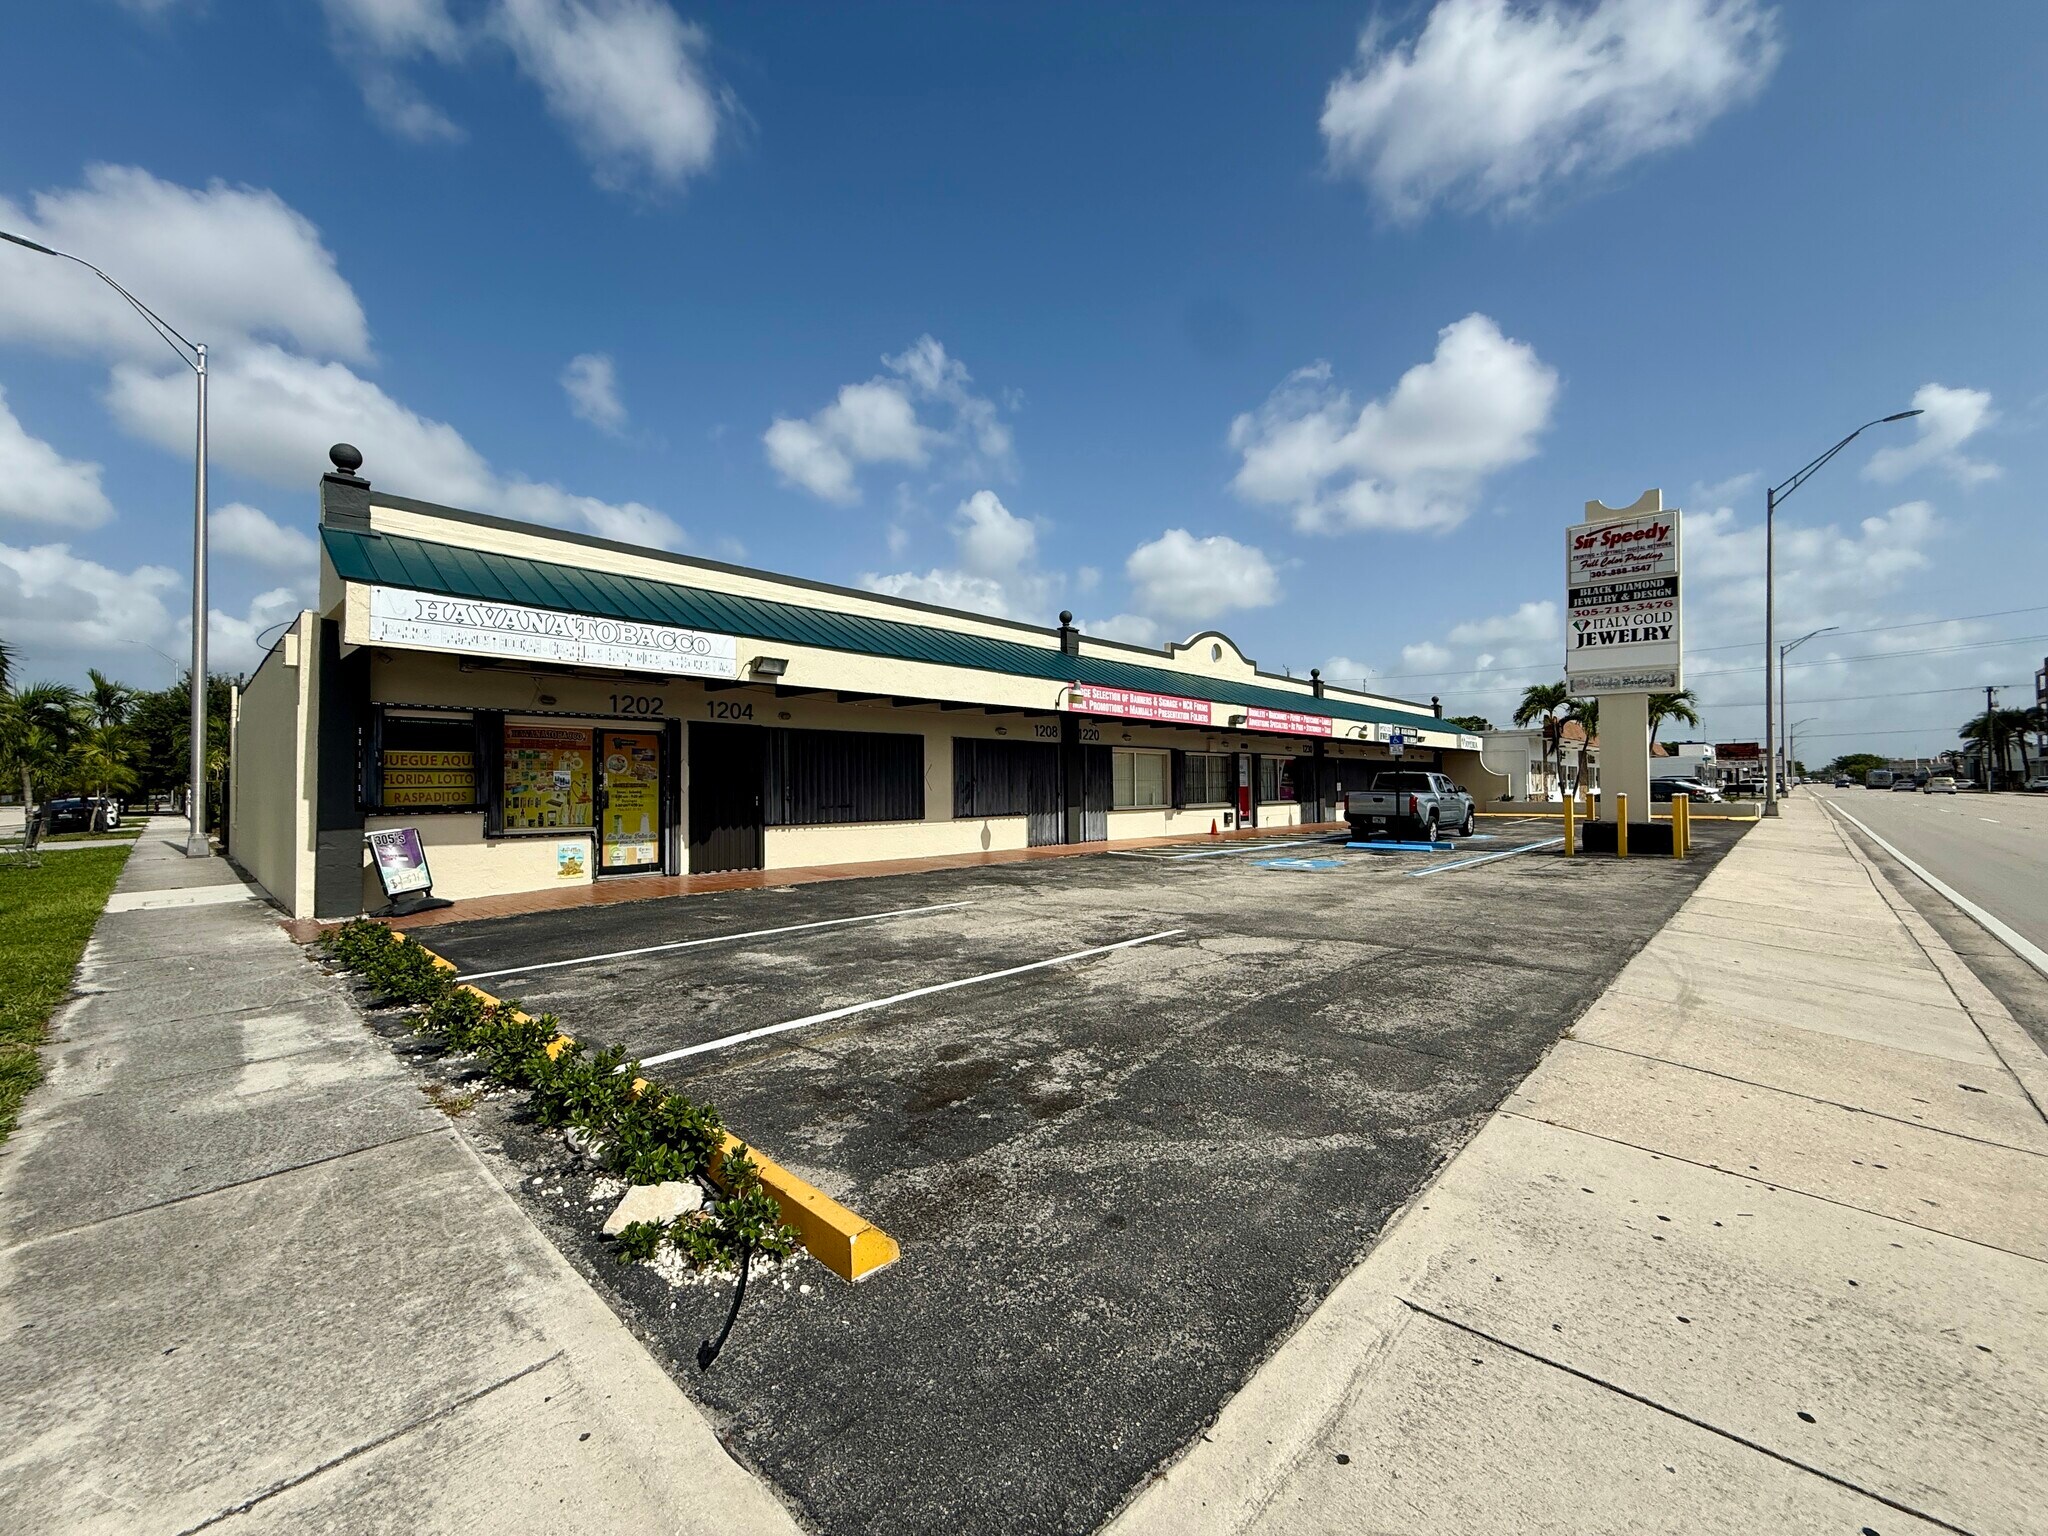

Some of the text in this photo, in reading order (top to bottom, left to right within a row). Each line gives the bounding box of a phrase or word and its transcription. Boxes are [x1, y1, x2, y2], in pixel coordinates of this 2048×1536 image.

[1573, 522, 1670, 551] Sir Speedy
[1573, 552, 1595, 560] PRINTING
[1647, 541, 1673, 550] NETWORK
[1579, 551, 1664, 571] Full Color Printing
[1590, 564, 1652, 578] 305-888-1547
[1573, 587, 1672, 608] JEWELRY & DESIGN
[1580, 579, 1665, 597] BLACK DIAMOND
[1573, 599, 1674, 618] 305-713-3476
[415, 599, 712, 656] HAVANA TOBACCO
[1593, 611, 1673, 630] ITALY GOLD
[499, 634, 542, 653] HOOKAH
[1576, 624, 1673, 649] JEWELRY
[609, 694, 664, 715] 1202
[1092, 687, 1121, 701] SELECTION
[1122, 692, 1129, 701] OF
[1130, 692, 1152, 706] BANNERS
[1153, 696, 1158, 706] &
[1158, 697, 1178, 709] SIGNAGE
[706, 700, 754, 720] 1204
[1089, 700, 1123, 713] PROMOTIONS
[1129, 704, 1153, 717] MANUALS
[1158, 708, 1190, 721] PRESENTATION
[1190, 711, 1209, 723] FOLDERS
[1034, 724, 1058, 738] 1208
[1079, 728, 1100, 741] 1220
[384, 754, 438, 766] JUEGUE
[384, 773, 474, 785] FLORIDA LOTTO
[394, 791, 467, 803] RASPADITOS
